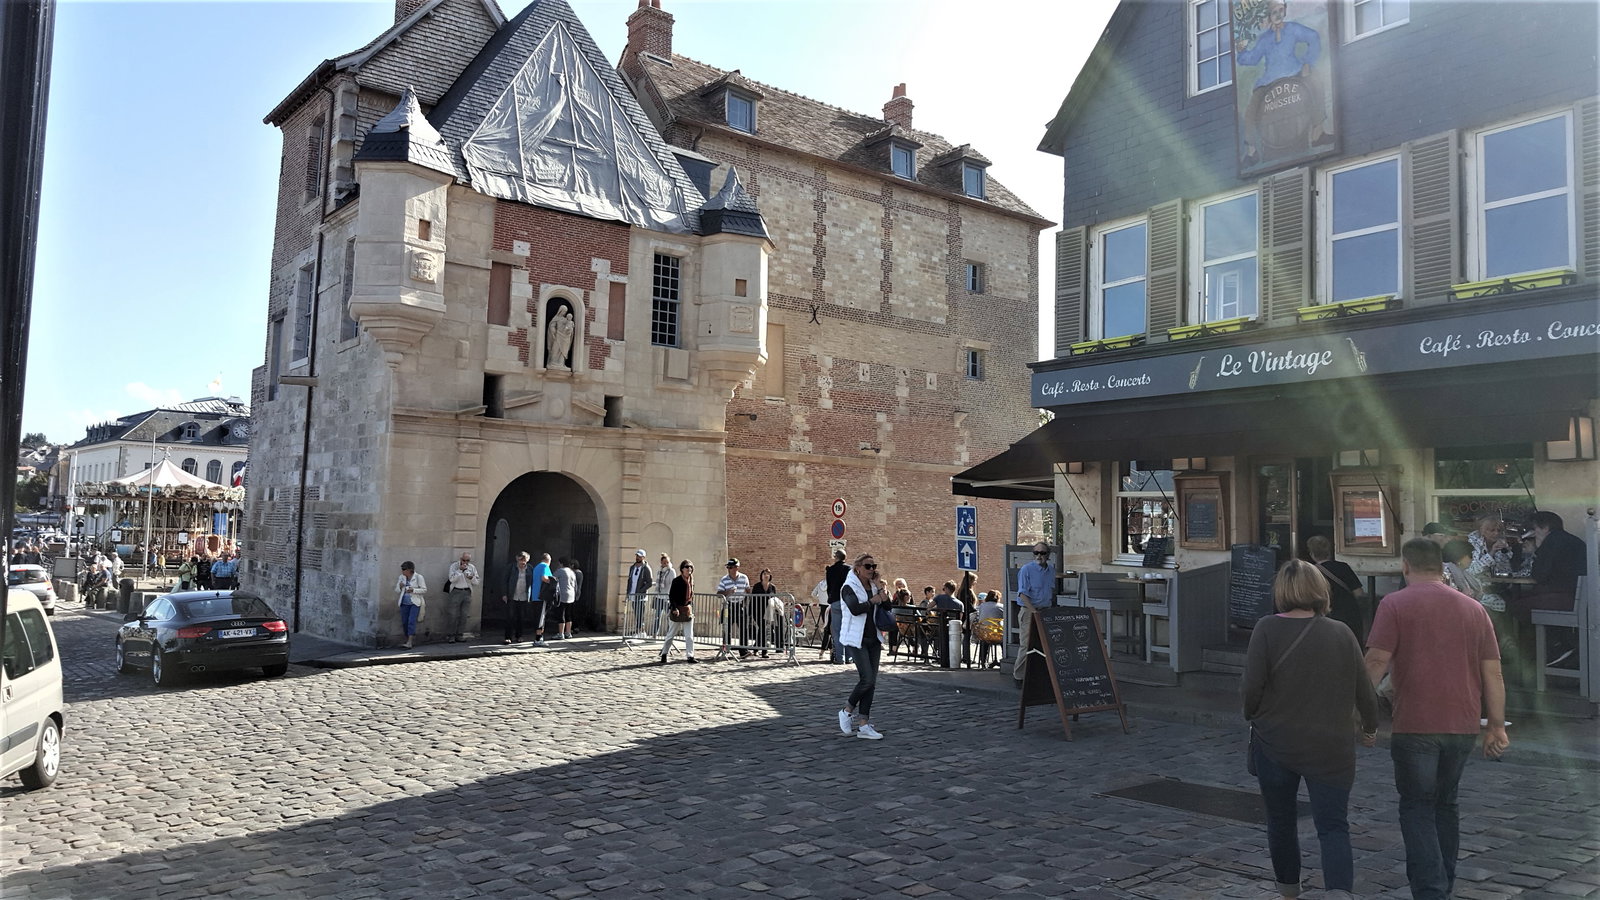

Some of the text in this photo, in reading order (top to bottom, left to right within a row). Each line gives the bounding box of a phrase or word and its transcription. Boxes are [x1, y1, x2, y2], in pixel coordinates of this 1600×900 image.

[1264, 83, 1299, 103] CIDRE
[1264, 94, 1302, 112] MOUSSEUX
[1420, 334, 1462, 357] Café
[1476, 329, 1532, 349] Resto
[1216, 350, 1333, 377] Le Vintage
[1041, 373, 1151, 398] Café Resto Concerts
[223, 629, 253, 638] AK-421-VX
